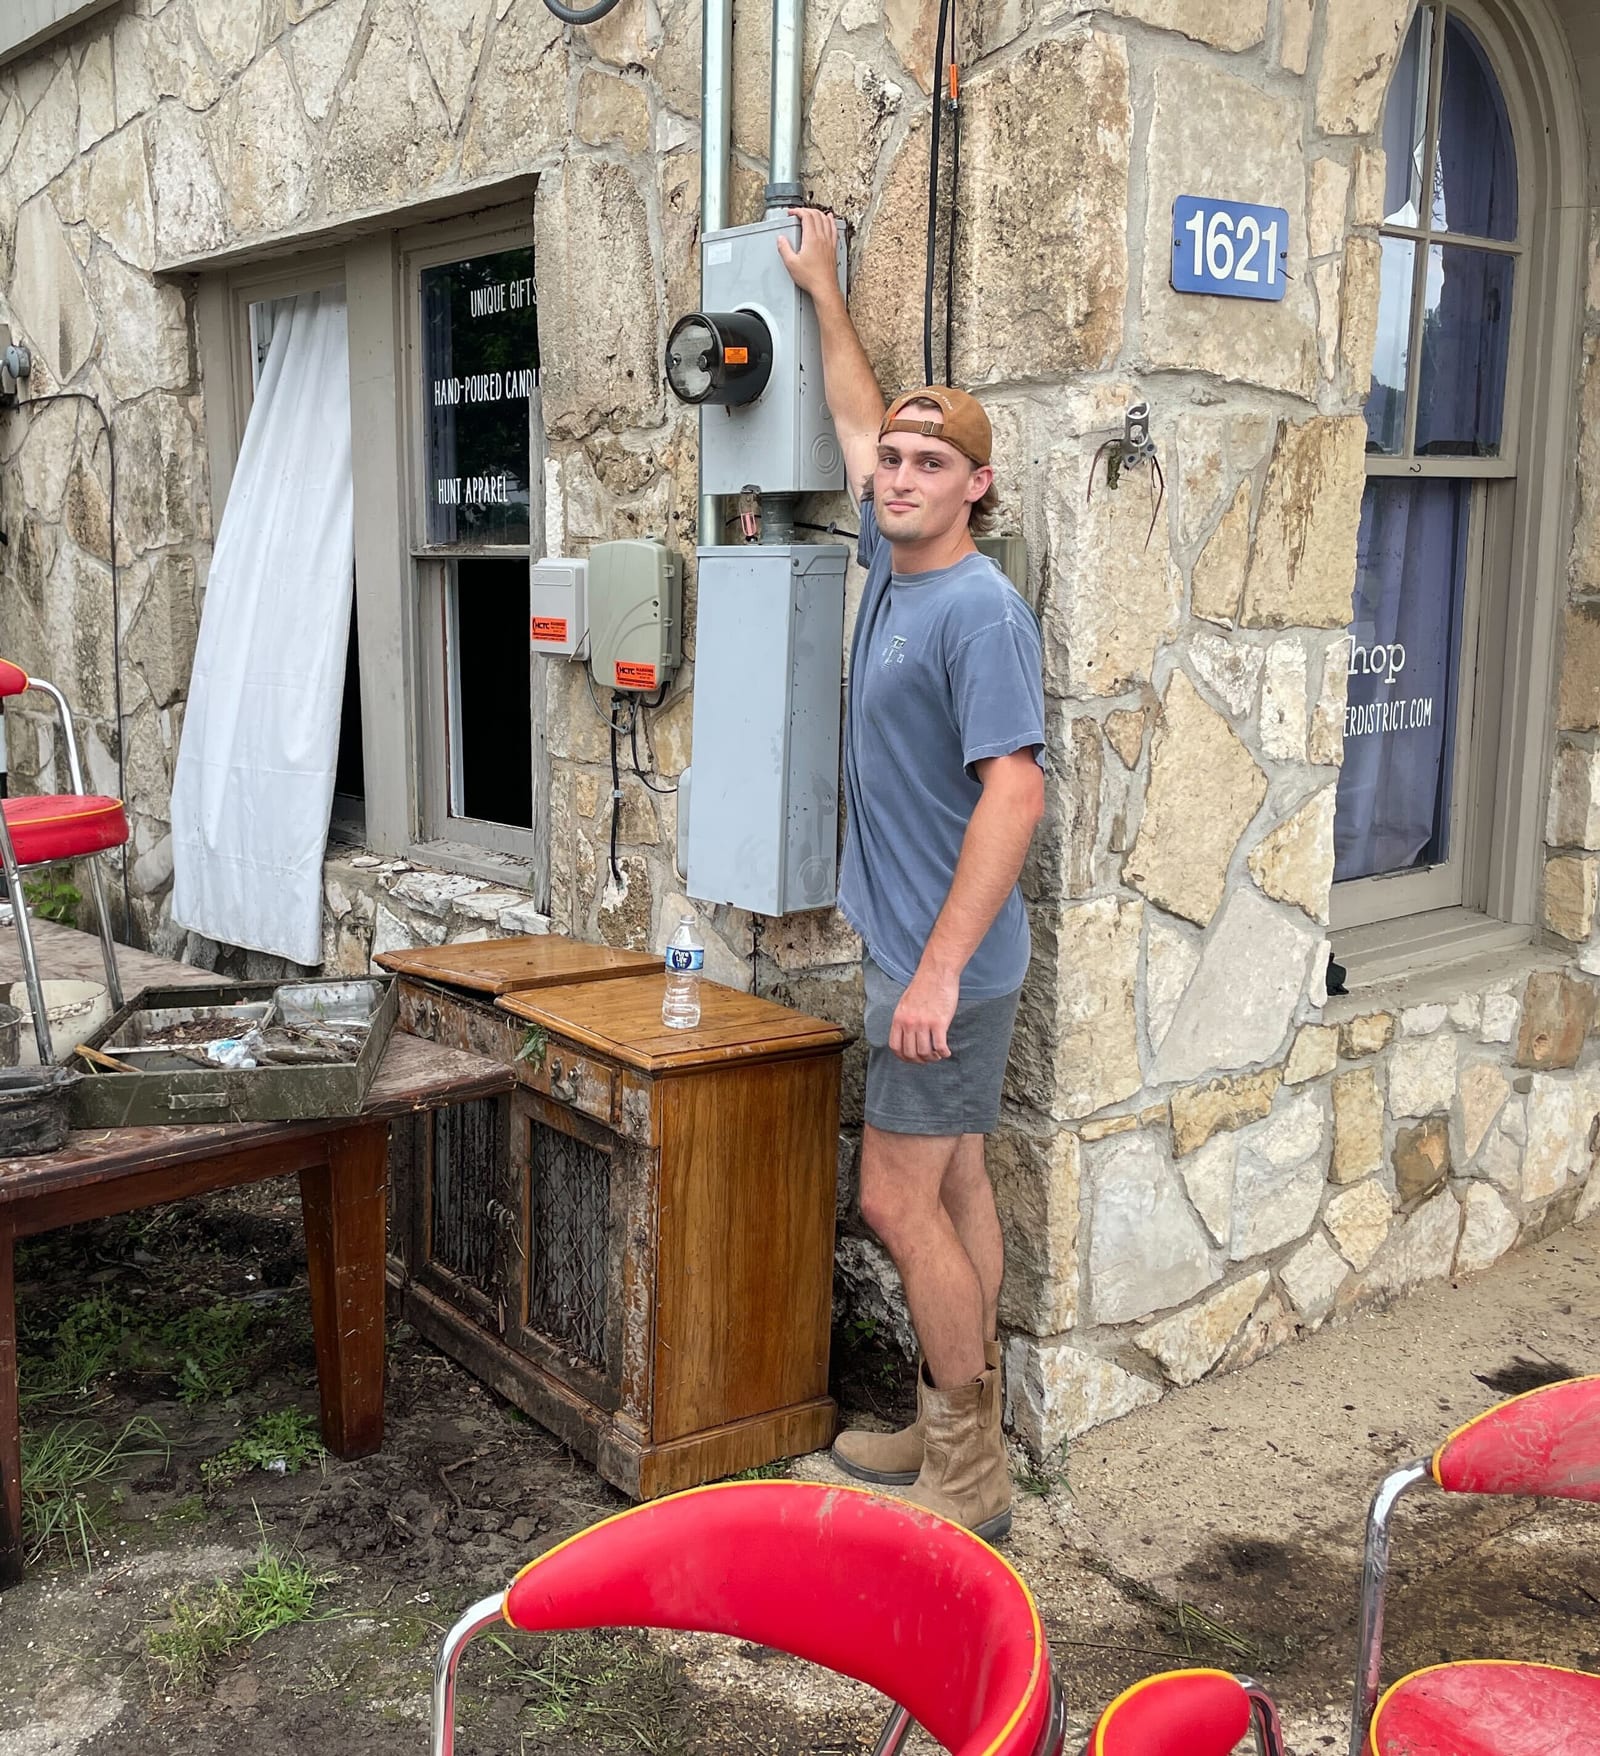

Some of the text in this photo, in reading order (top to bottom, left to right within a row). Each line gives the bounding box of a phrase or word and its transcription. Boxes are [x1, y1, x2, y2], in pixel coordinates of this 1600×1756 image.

[1185, 209, 1278, 285] 1621
[470, 283, 507, 318] UNIQUE
[434, 372, 502, 406] HAND-POURED
[438, 475, 508, 504] HUNT APPAREL
[619, 666, 636, 675] HCTC
